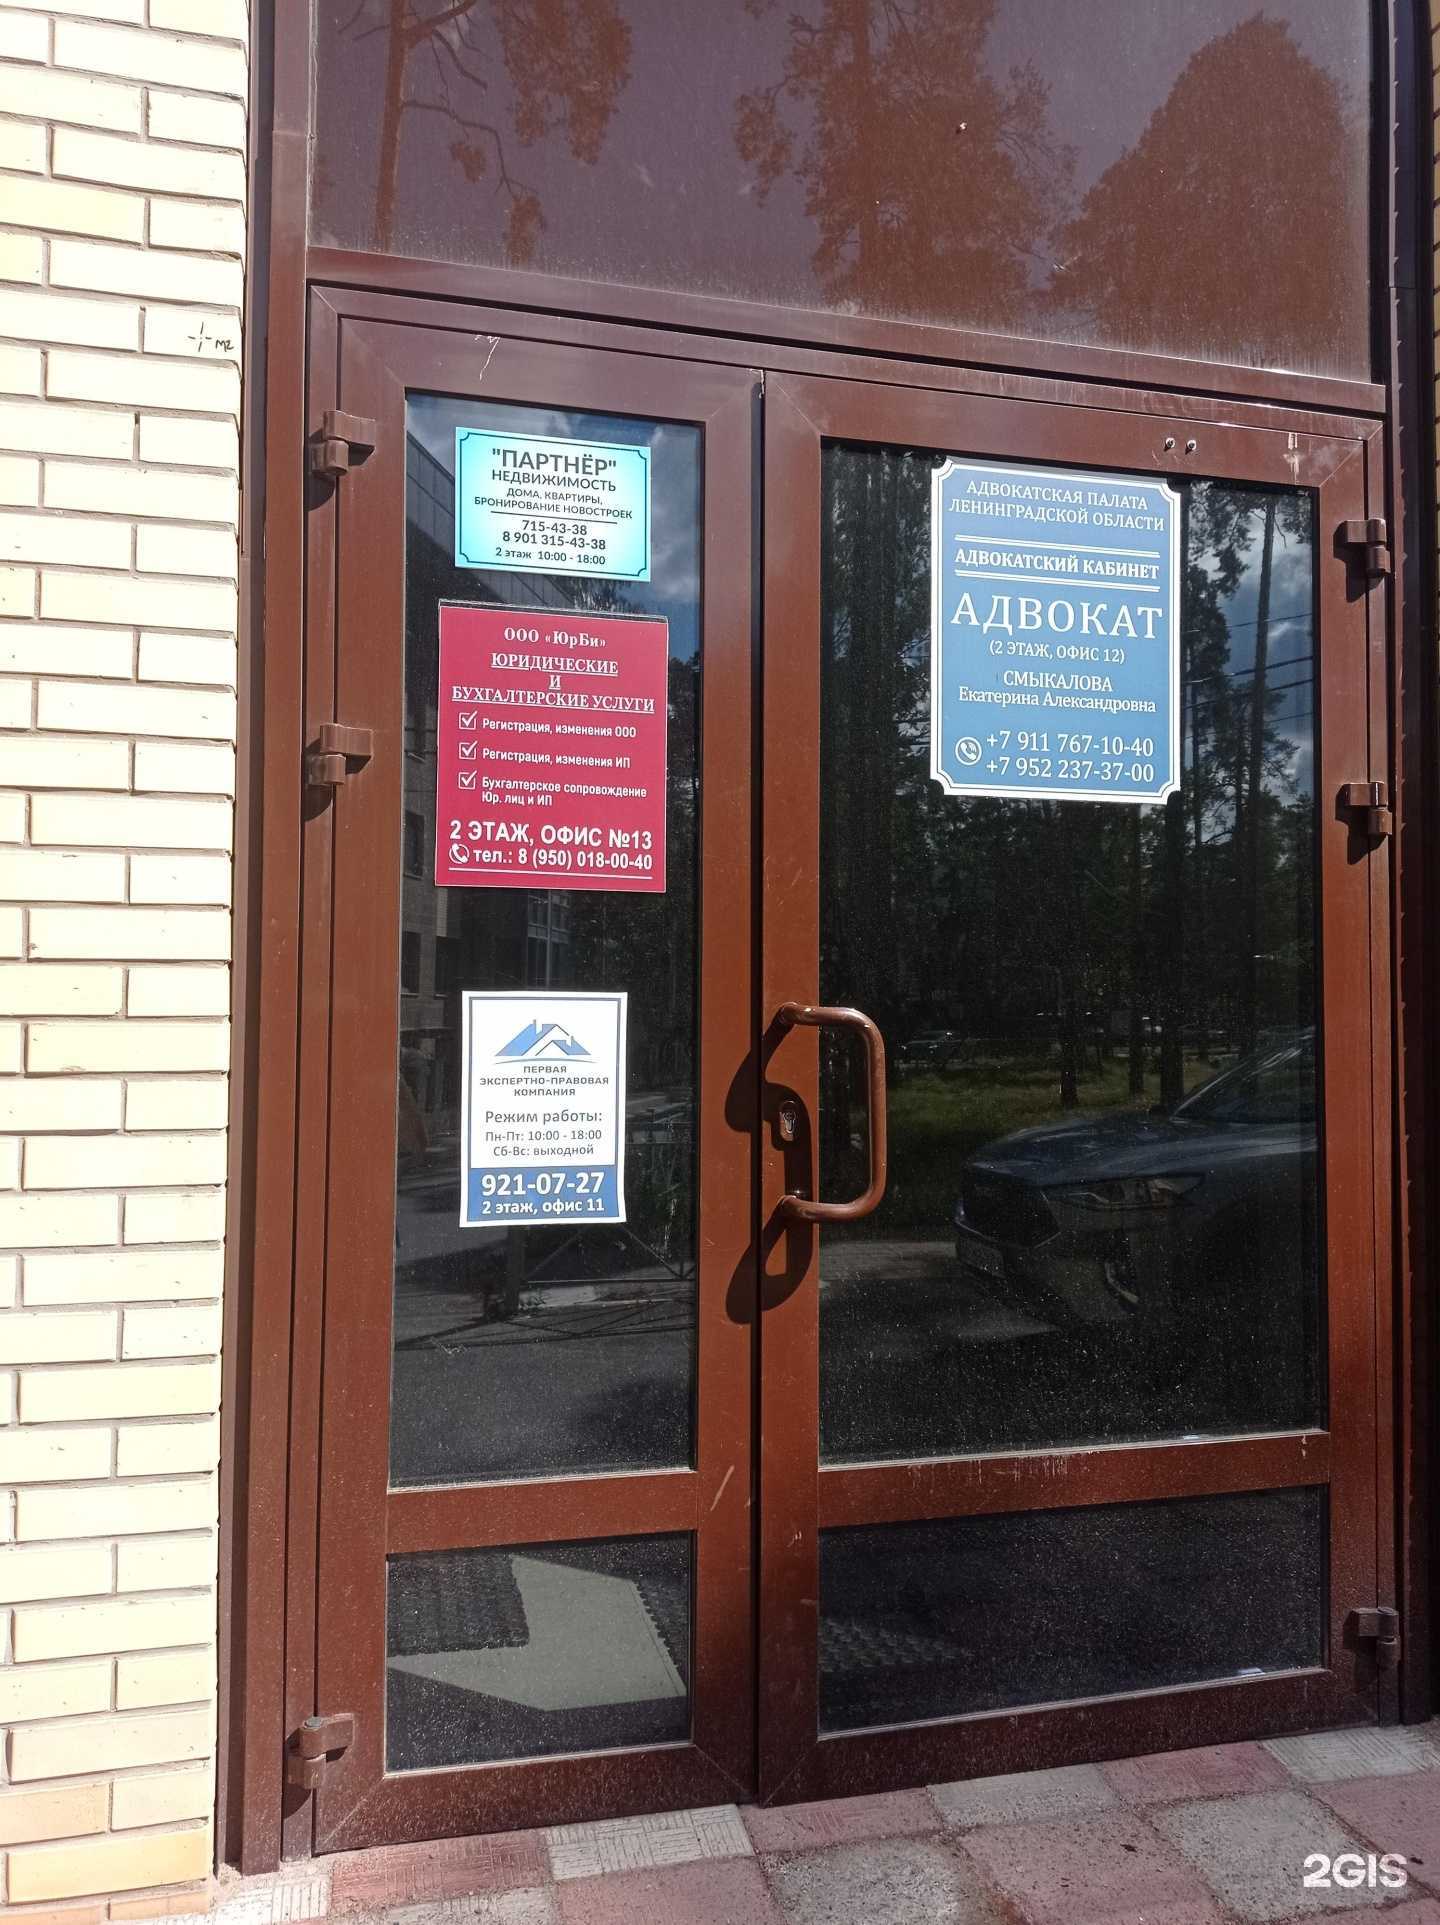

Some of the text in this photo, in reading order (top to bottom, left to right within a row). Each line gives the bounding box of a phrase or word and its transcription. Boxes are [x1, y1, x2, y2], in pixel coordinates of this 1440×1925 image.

[492, 448, 617, 476] "ПАРТНЁР"
[491, 469, 617, 492] НЕДВИЖИМОСТЬ
[544, 491, 603, 505] КВАРТИРЫ,
[966, 479, 1148, 510] АДВОКАТСКАЯ ПАЛАТА
[474, 496, 633, 519] БРОНИРОВАНИЕ НОВОСТРОЕК
[949, 497, 1165, 531] ЛЕНИНГРАДСКОЙ ОБЛАСТИ
[522, 520, 588, 536] 715-43-38
[502, 531, 606, 550] 8 901 315-43-38
[495, 547, 502, 557] 2
[504, 549, 532, 559] этаж
[538, 551, 567, 562] 10:00
[577, 554, 606, 565] 18:00
[954, 548, 1159, 580] АДВОКАТСКИЙ КАБИНЕТ
[949, 592, 1163, 639] АДВОКАТ
[504, 627, 607, 649] ООО «ЮрБи»
[989, 640, 1126, 665] (2 ЭТАЖ, ОФИС 12)
[491, 652, 619, 676] ЮРИДИЧЕСКИЕ
[548, 674, 561, 690] И
[1002, 670, 1114, 692] СМЫКАЛОВА
[451, 685, 655, 714] БУХГАЛТЕРСКИЕ УСЛУГИ
[958, 686, 1157, 714] Екатерина Александровна
[481, 718, 637, 738] Регистрация, изменения ООО
[986, 730, 1154, 757] +7 911 767-10-40
[481, 748, 631, 769] Регистрация, изменения ИП
[985, 756, 1154, 783] +7 952 237-37-00
[481, 777, 648, 798] Бухгалтерское сопровождение
[481, 792, 553, 806] Юр. лиц и ИП
[450, 820, 653, 850] 2 ЭТАЖ, ОФИС №13
[472, 847, 653, 870] тел.: 8 (950) 018-00-40
[523, 1065, 567, 1074] ПЕРВАЯ
[479, 1077, 609, 1086] ЭКСПЕРТНО-ПРАВОВАЯ
[513, 1088, 576, 1097] КОМПАНИЯ
[485, 1109, 603, 1126] Режим работы:
[485, 1131, 524, 1142] Пн-Пт:
[528, 1130, 560, 1141] 10:00
[570, 1130, 602, 1140] 18:00
[493, 1145, 595, 1157] Сб-Вс: выходной
[480, 1171, 605, 1196] 921-07-27
[482, 1198, 604, 1215] 2 этаж, офис 11
